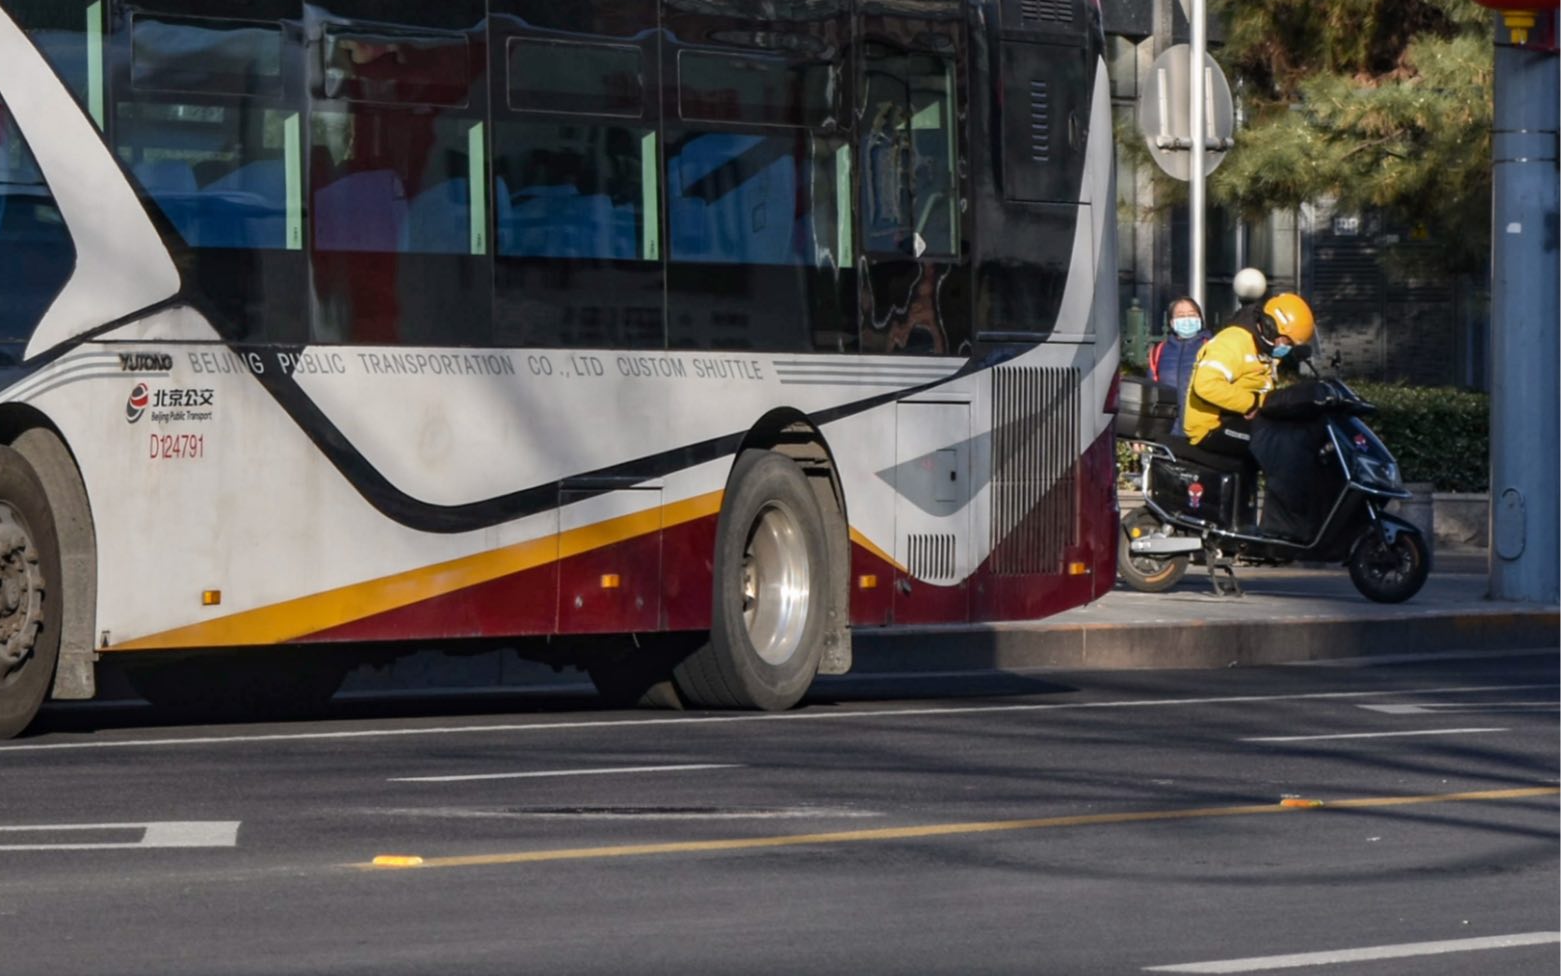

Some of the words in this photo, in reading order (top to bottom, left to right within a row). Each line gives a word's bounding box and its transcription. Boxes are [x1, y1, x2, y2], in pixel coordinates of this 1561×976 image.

[119, 353, 173, 371] YUTONG
[187, 351, 264, 374] BEIJING
[278, 351, 346, 375] PUBLIC
[358, 352, 516, 376] TRANSPORTATION
[617, 356, 687, 379] CUSTOM
[692, 358, 765, 381] SHUTTLE
[152, 389, 214, 407] 北京公交
[151, 411, 169, 424] Beijing
[170, 410, 186, 422] Public
[186, 411, 213, 422] Transport
[149, 434, 204, 459] D124791
